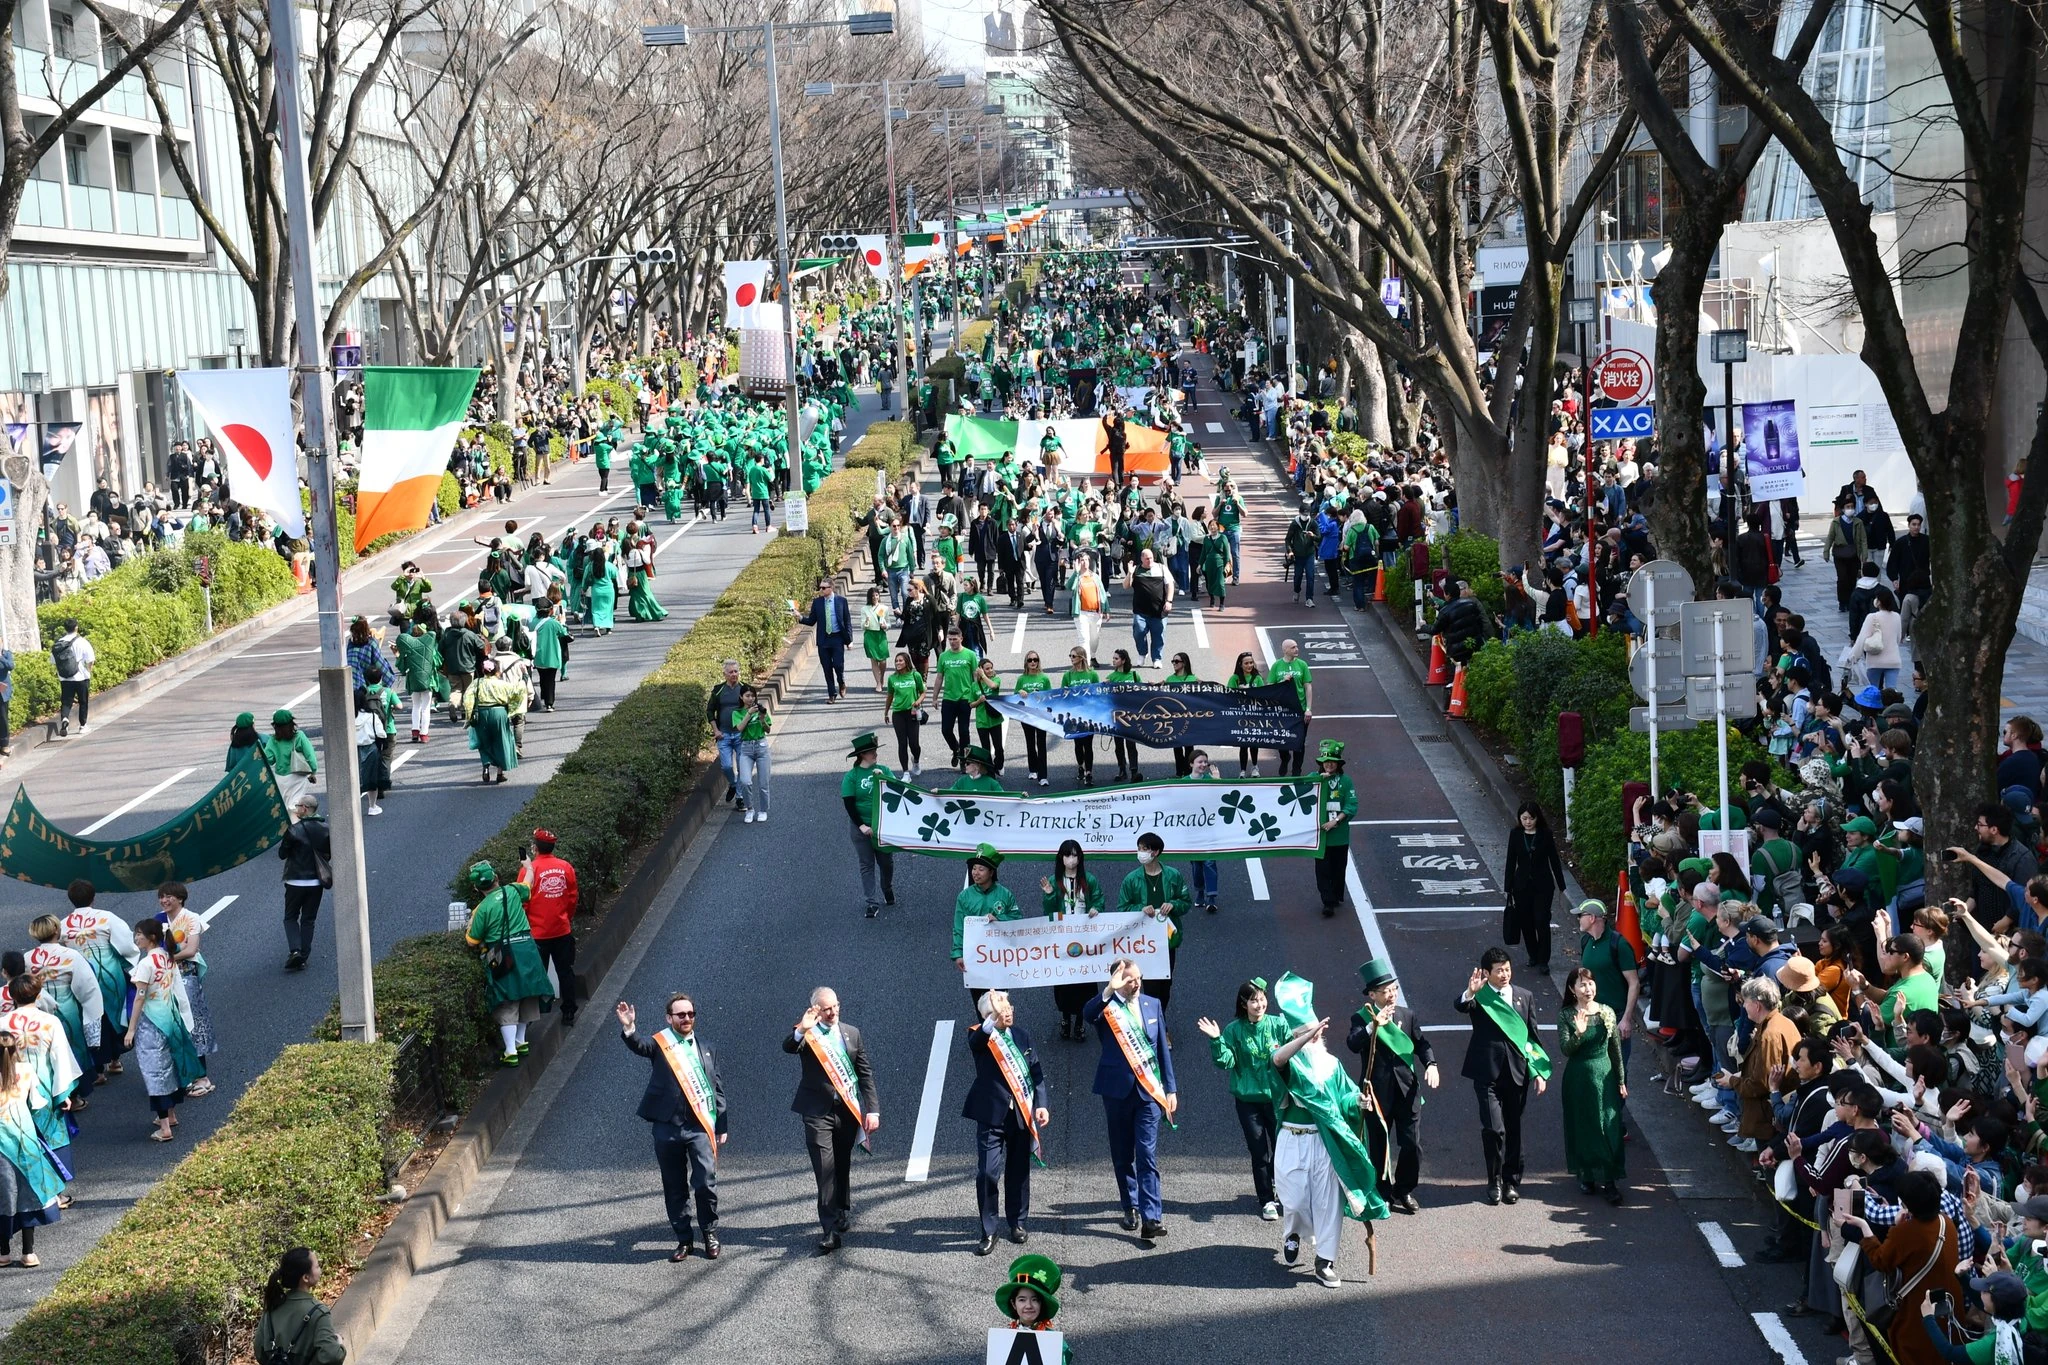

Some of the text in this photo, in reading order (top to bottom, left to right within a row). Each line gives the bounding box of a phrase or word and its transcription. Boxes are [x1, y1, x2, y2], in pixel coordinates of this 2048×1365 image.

[1603, 370, 1640, 388] 消火栓
[1112, 704, 1215, 728] Riverdance
[1153, 721, 1174, 737] 25
[1084, 803, 1112, 811] presents
[1120, 793, 1151, 803] Japan
[28, 770, 252, 862] 日本アイルランド協会
[1110, 812, 1145, 834] Day
[1083, 832, 1114, 847] Tokyo
[540, 868, 566, 878] GUARDIAN
[976, 934, 1157, 968] Support Our Kids
[1005, 1053, 1019, 1073] GRAND
